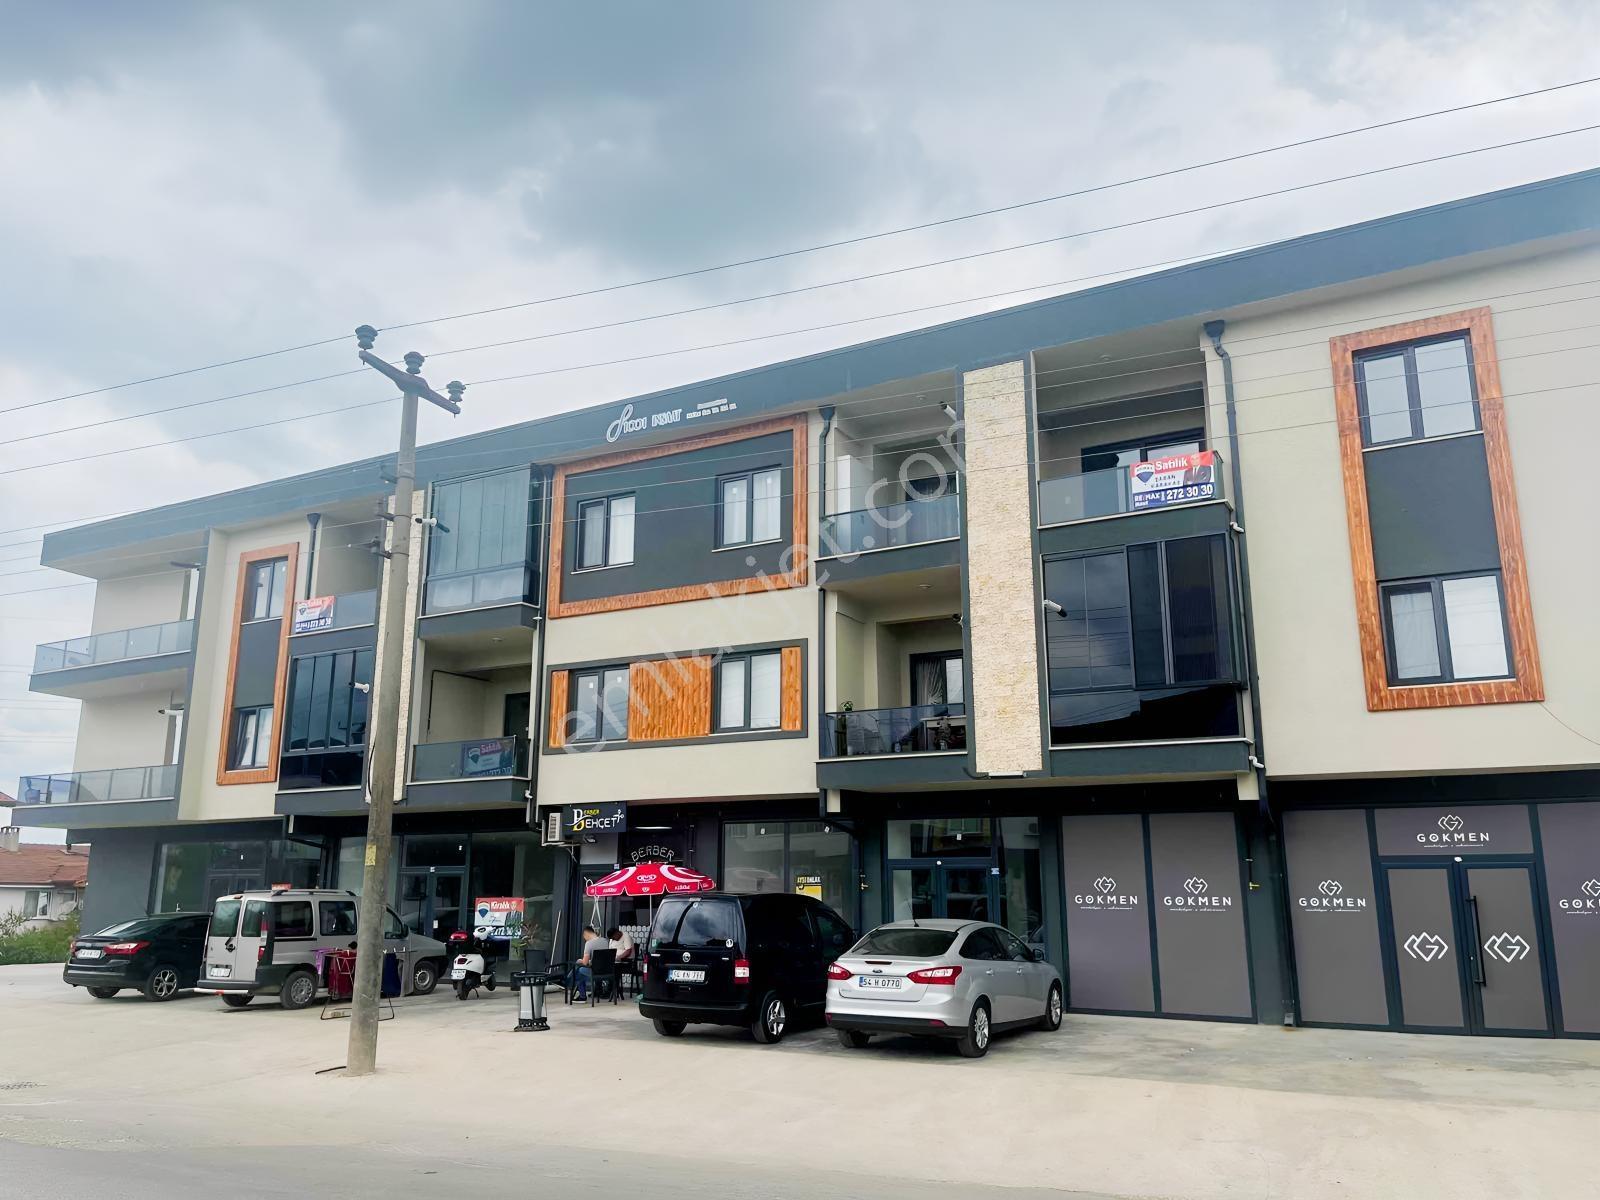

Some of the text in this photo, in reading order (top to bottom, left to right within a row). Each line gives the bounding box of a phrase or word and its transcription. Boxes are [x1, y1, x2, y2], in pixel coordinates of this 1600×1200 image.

[1166, 488, 1185, 500] 272
[1187, 486, 1199, 498] 30
[1201, 483, 1213, 495] 30
[631, 845, 675, 862] BERBER
[1559, 899, 1600, 909] GOK
[863, 978, 872, 986] 54
[881, 979, 900, 987] 0770
